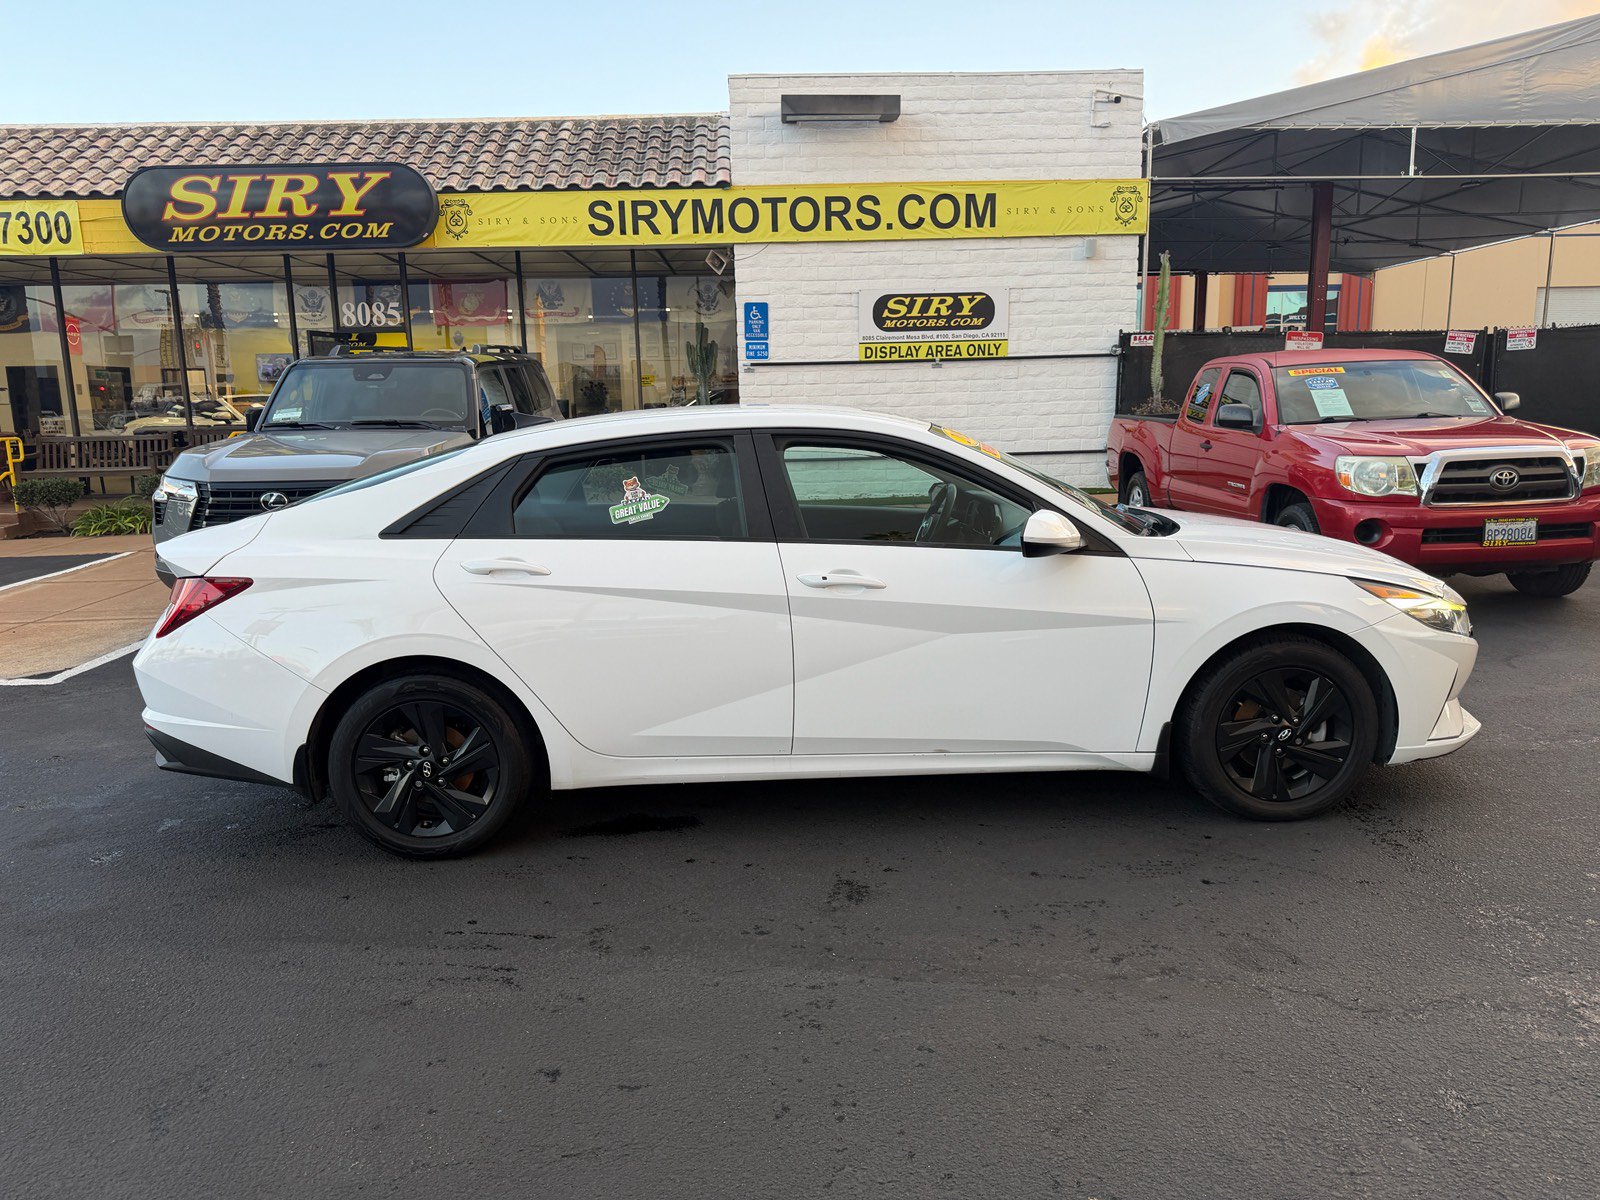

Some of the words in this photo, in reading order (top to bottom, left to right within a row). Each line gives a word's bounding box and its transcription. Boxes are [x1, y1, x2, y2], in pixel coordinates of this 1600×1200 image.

[161, 171, 392, 221] SIRY
[477, 217, 512, 226] SIRY
[522, 216, 529, 225] &
[540, 216, 578, 225] SONS
[587, 192, 997, 237] SIRYMOTORS.COM
[1006, 206, 1040, 216] SIRY
[1049, 206, 1056, 215] &
[1066, 205, 1104, 214] SONS
[0, 210, 72, 245] 7300
[167, 222, 394, 243] MOTORS.COM
[341, 301, 401, 327] 8085
[882, 295, 986, 318] SIRY
[882, 317, 986, 328] MOTORS.COM
[864, 345, 921, 359] DISPLAY
[925, 344, 962, 358] AREA
[966, 343, 1002, 357] ONLY
[615, 504, 637, 519] GREAT
[638, 498, 660, 512] VALUE
[1487, 528, 1533, 540] 8P98084
